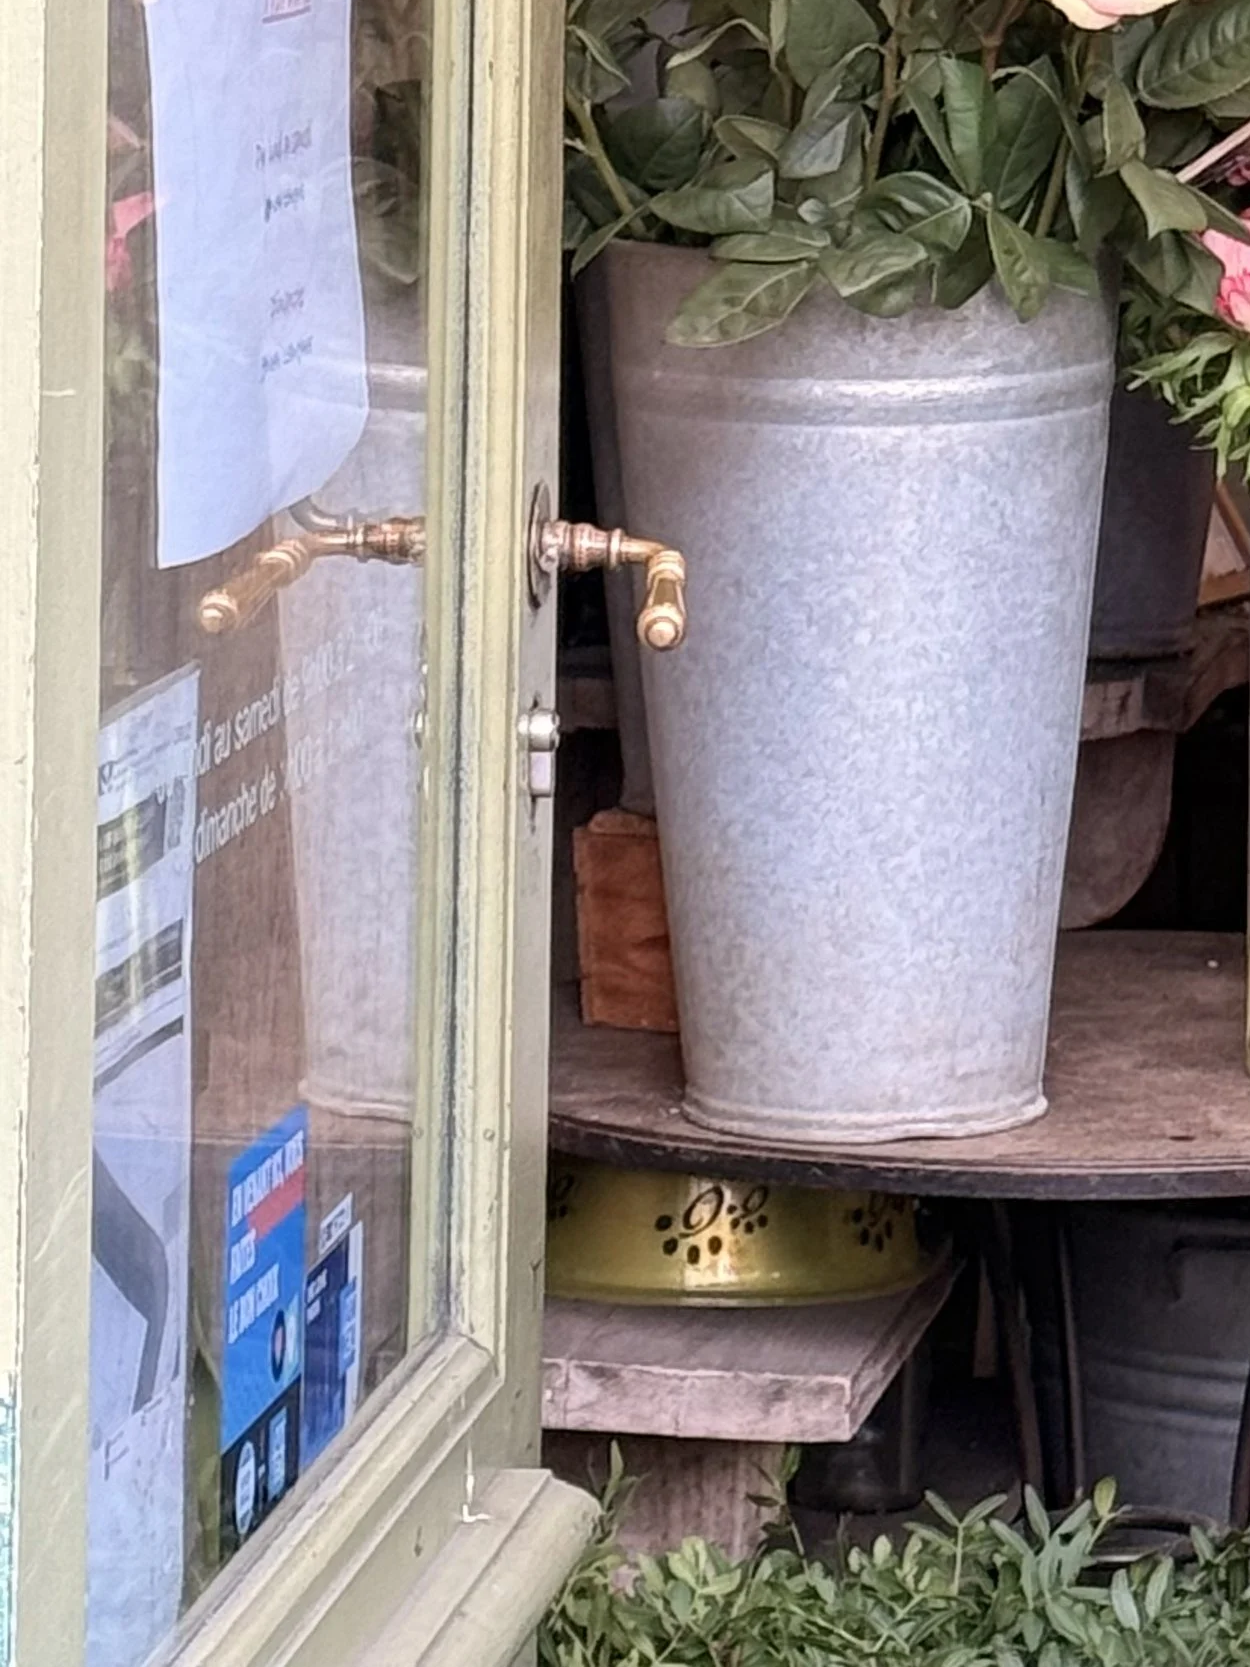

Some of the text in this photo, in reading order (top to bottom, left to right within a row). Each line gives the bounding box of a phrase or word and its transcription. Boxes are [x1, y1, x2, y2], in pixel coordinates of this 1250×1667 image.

[213, 724, 231, 765] au
[233, 675, 281, 751] samedi
[194, 777, 259, 863] dimanche
[259, 764, 278, 817] de
